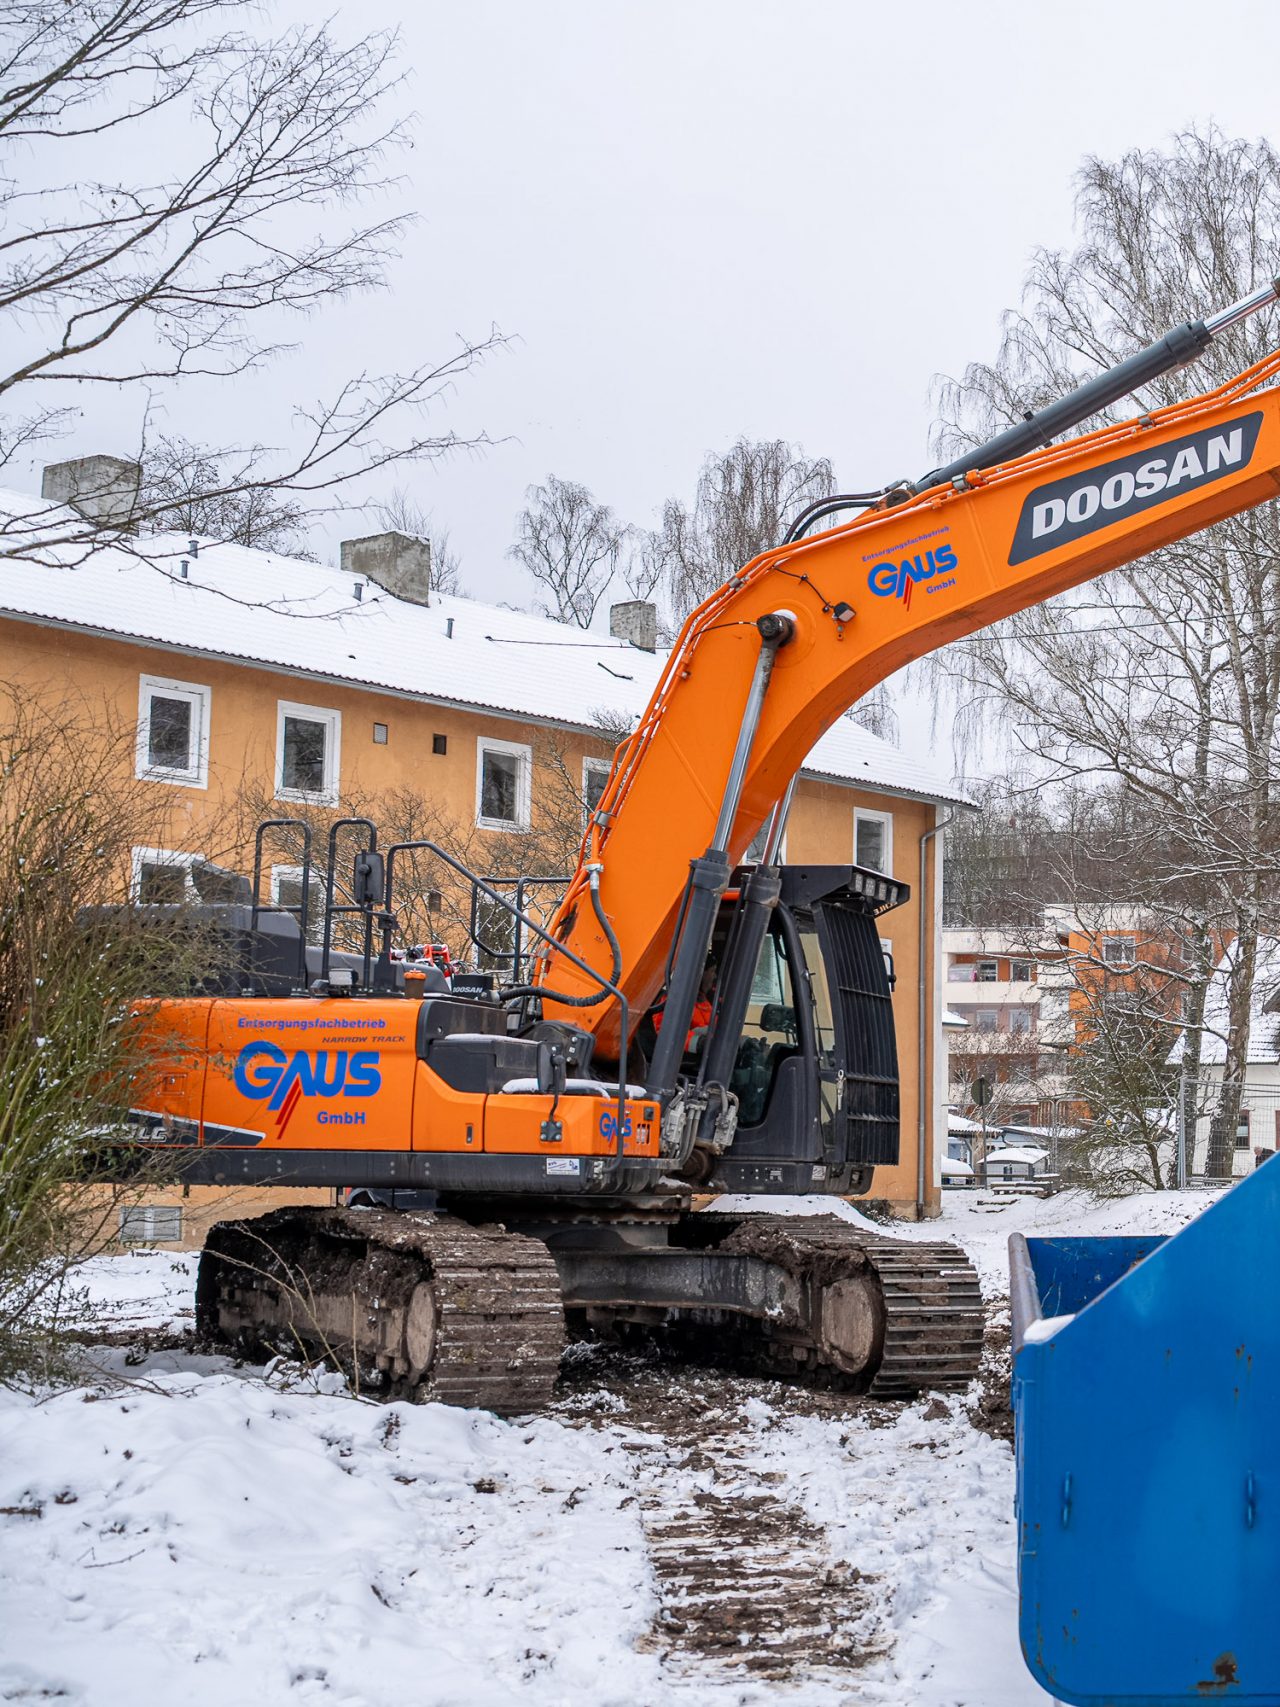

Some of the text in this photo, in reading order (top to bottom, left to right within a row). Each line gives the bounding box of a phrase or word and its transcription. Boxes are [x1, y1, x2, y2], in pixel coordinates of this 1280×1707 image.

[1032, 428, 1243, 539] DOOSAN
[867, 544, 958, 599] GAUS
[926, 578, 956, 594] GmbH
[238, 1017, 386, 1030] Entsorgungsfachbetrieb
[233, 1040, 382, 1111] GAUS
[317, 1111, 366, 1125] GmbH
